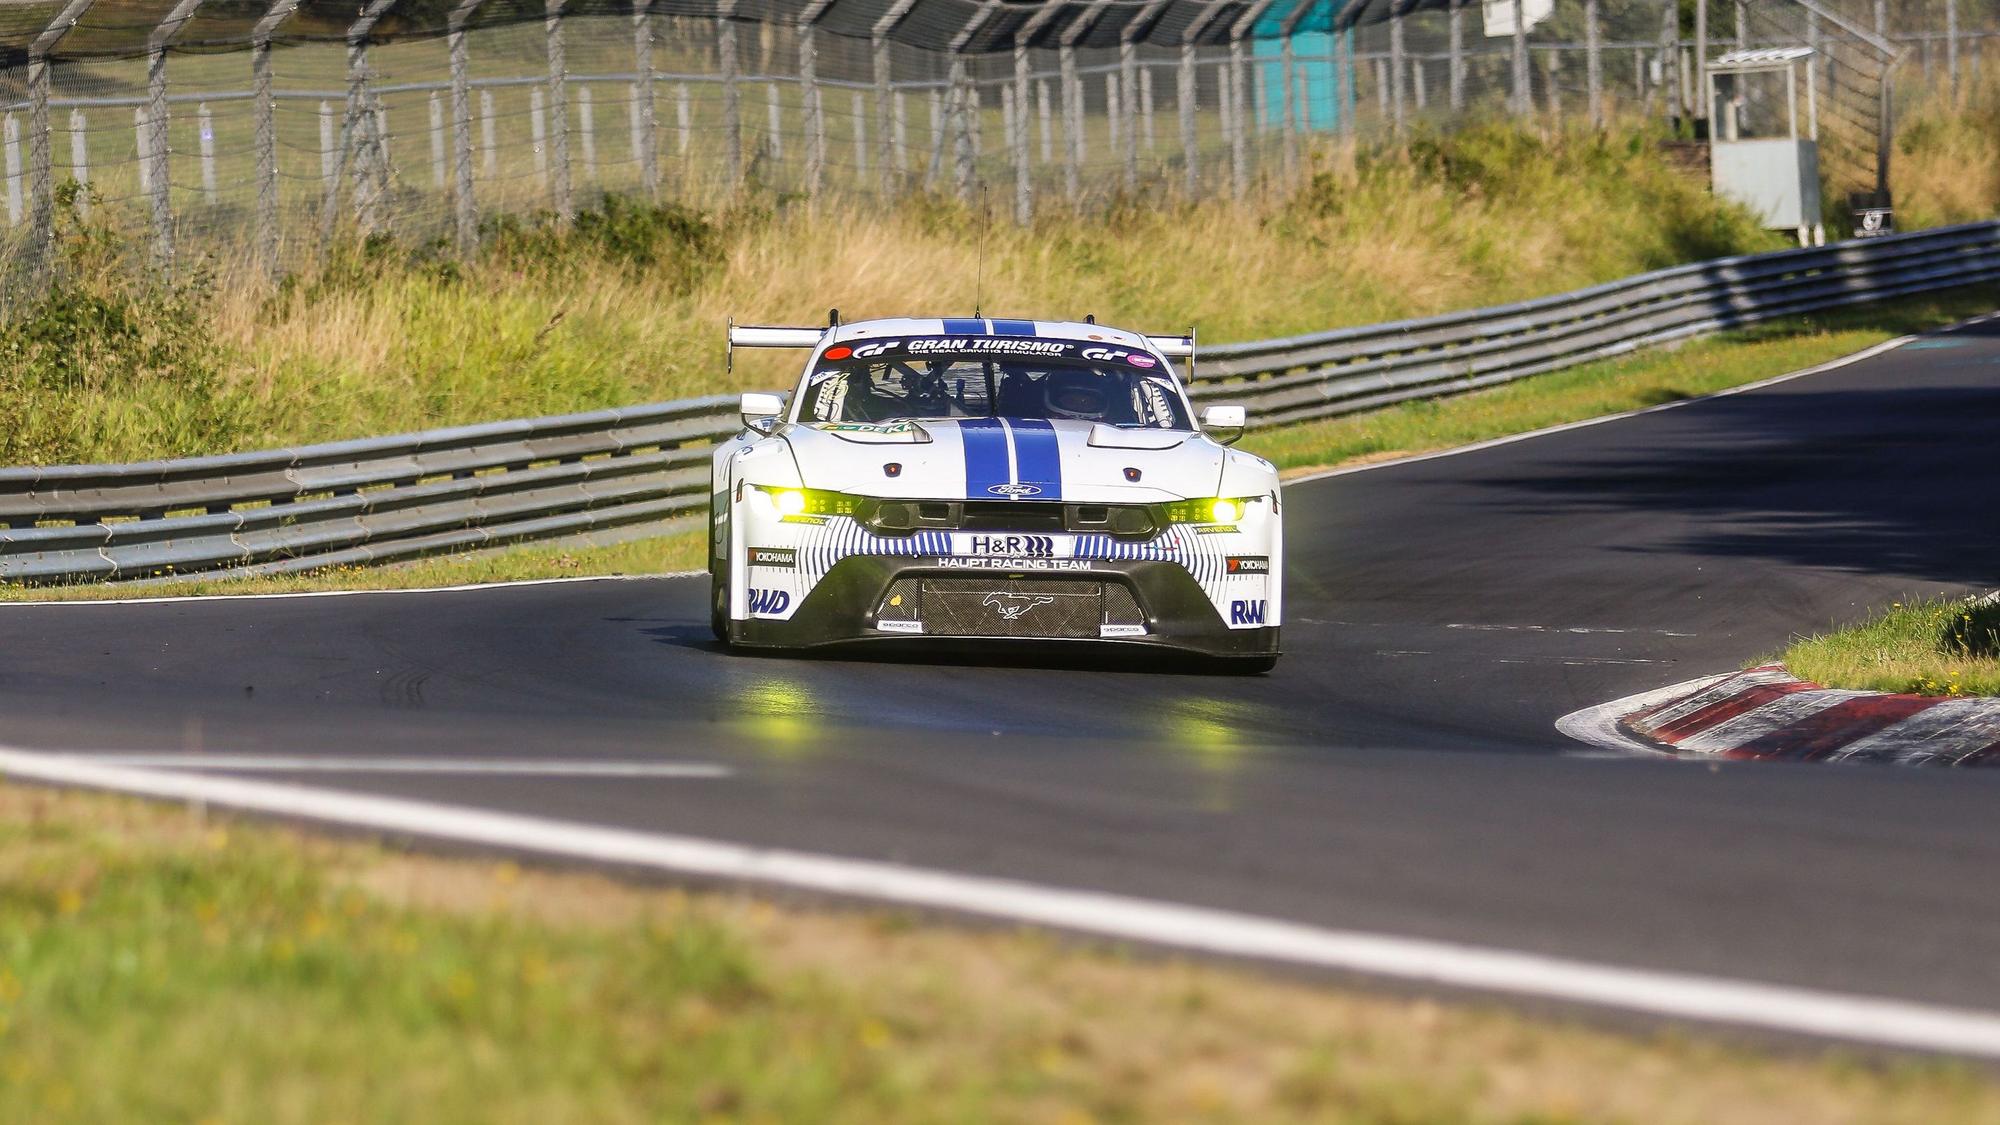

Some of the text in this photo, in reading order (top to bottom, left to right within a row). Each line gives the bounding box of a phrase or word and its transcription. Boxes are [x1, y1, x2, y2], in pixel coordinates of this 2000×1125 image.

[907, 339, 968, 350] GRAN
[997, 484, 1032, 495] Ford
[755, 551, 794, 563] YOKOHAMA
[938, 557, 1091, 570] HAUPT RACING TEAM
[1231, 599, 1267, 625] RW
